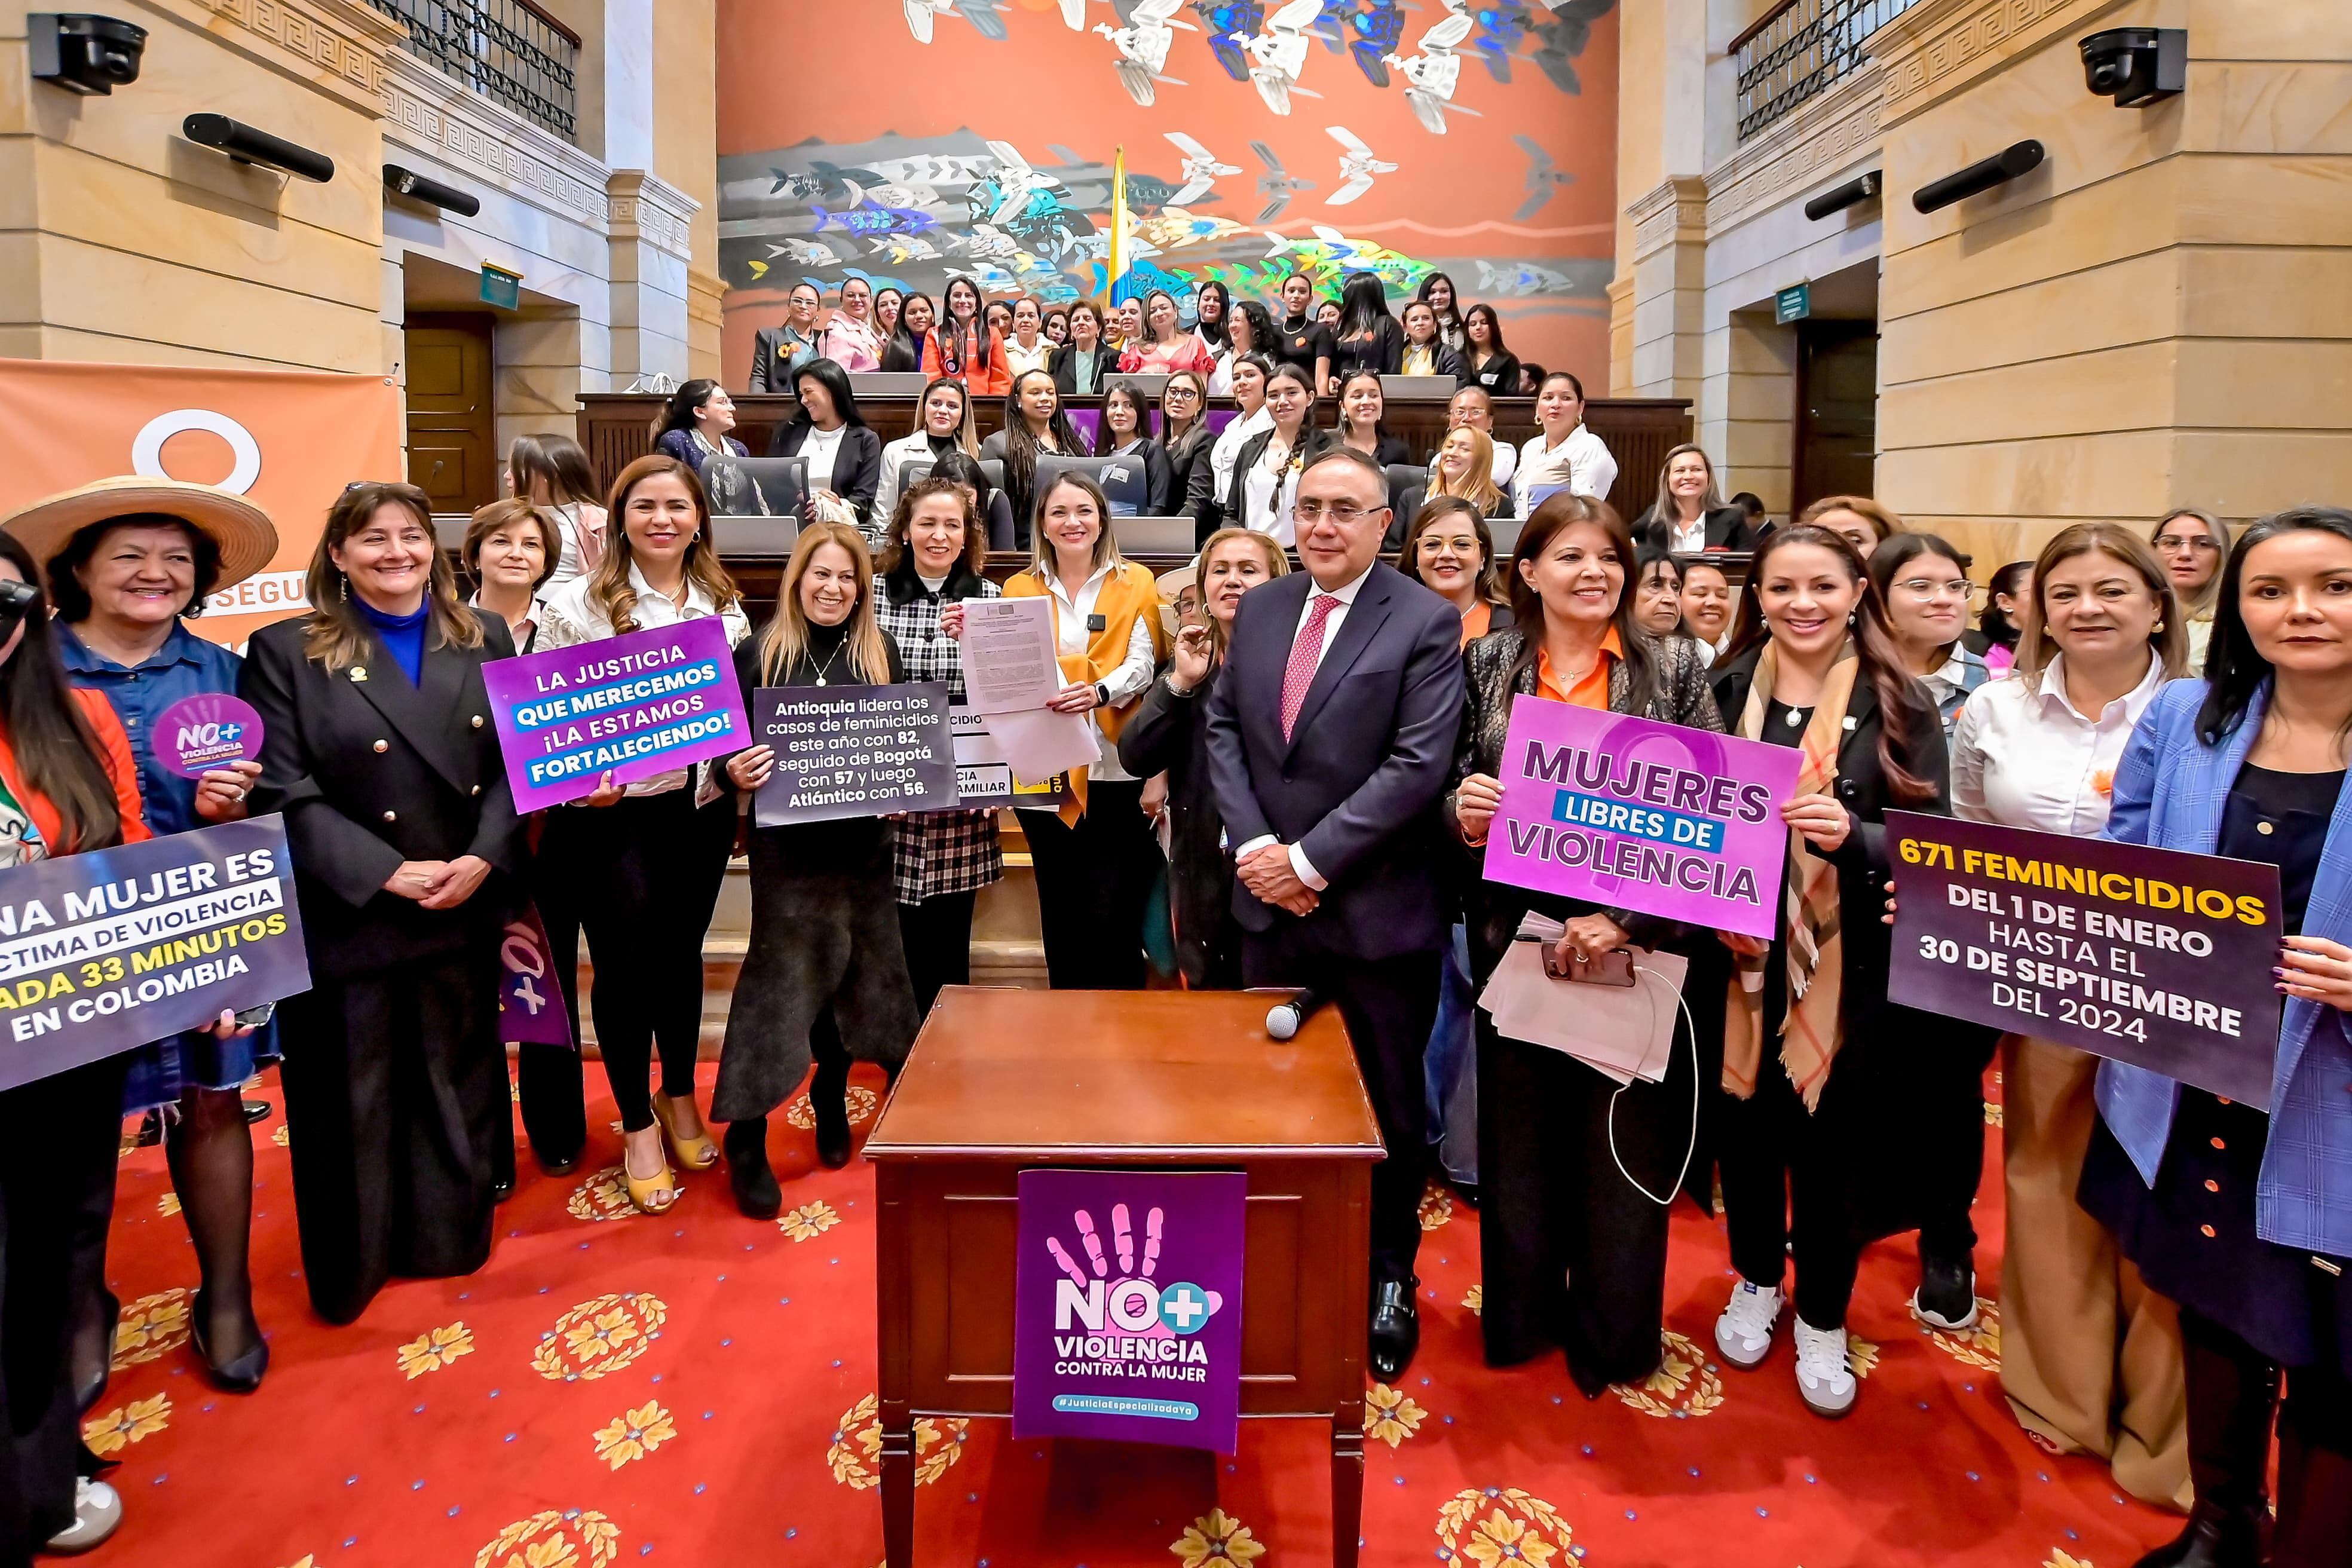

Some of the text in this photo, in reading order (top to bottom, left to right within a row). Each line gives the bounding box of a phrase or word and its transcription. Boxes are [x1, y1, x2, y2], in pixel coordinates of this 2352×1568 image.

[516, 663, 716, 728] QUE MERECEMOS
[535, 645, 687, 693] LA JUSTICIA
[543, 694, 705, 754] ¡LA ESTAMOS
[766, 712, 939, 735] casos de feminicidios
[775, 696, 929, 721] Antioquia lidera los
[950, 715, 982, 725] CIDIO
[179, 742, 243, 759] VIOLENCIA
[531, 712, 732, 783] FORTALECIENDO!
[778, 746, 932, 773] seguido de Bogotá
[788, 731, 920, 752] este año con 82,
[788, 781, 929, 808] Atlántico con 56.
[798, 766, 915, 788] con 57 y luego
[957, 771, 977, 781] CIA
[1523, 739, 1771, 824] MUJERES
[1565, 795, 1713, 848] LIBRES DE
[63, 862, 219, 921] MUJER
[226, 849, 274, 881] ES
[1505, 819, 1761, 906] VIOLENCIA
[1898, 838, 2266, 926] 671 FEMINICIDIOS
[94, 924, 128, 948] DE
[136, 889, 275, 937] VIOLENCIA
[1948, 884, 2213, 957] DEL 1 DE ENERO
[82, 957, 125, 988] 33
[131, 914, 287, 975] MINUTOS
[1989, 921, 2146, 978] HASTA EL
[11, 955, 249, 1042] EN COLOMBIA
[1919, 934, 2242, 1037] 30 DE SEPTIEMBRE
[1992, 983, 2148, 1044] DEL 2024
[1054, 1336, 1208, 1364] VIOLENCIA
[1055, 1361, 1206, 1382] CONTRA LA MUJER
[1059, 1398, 1192, 1416] #JusticiaEspecializadaYa
